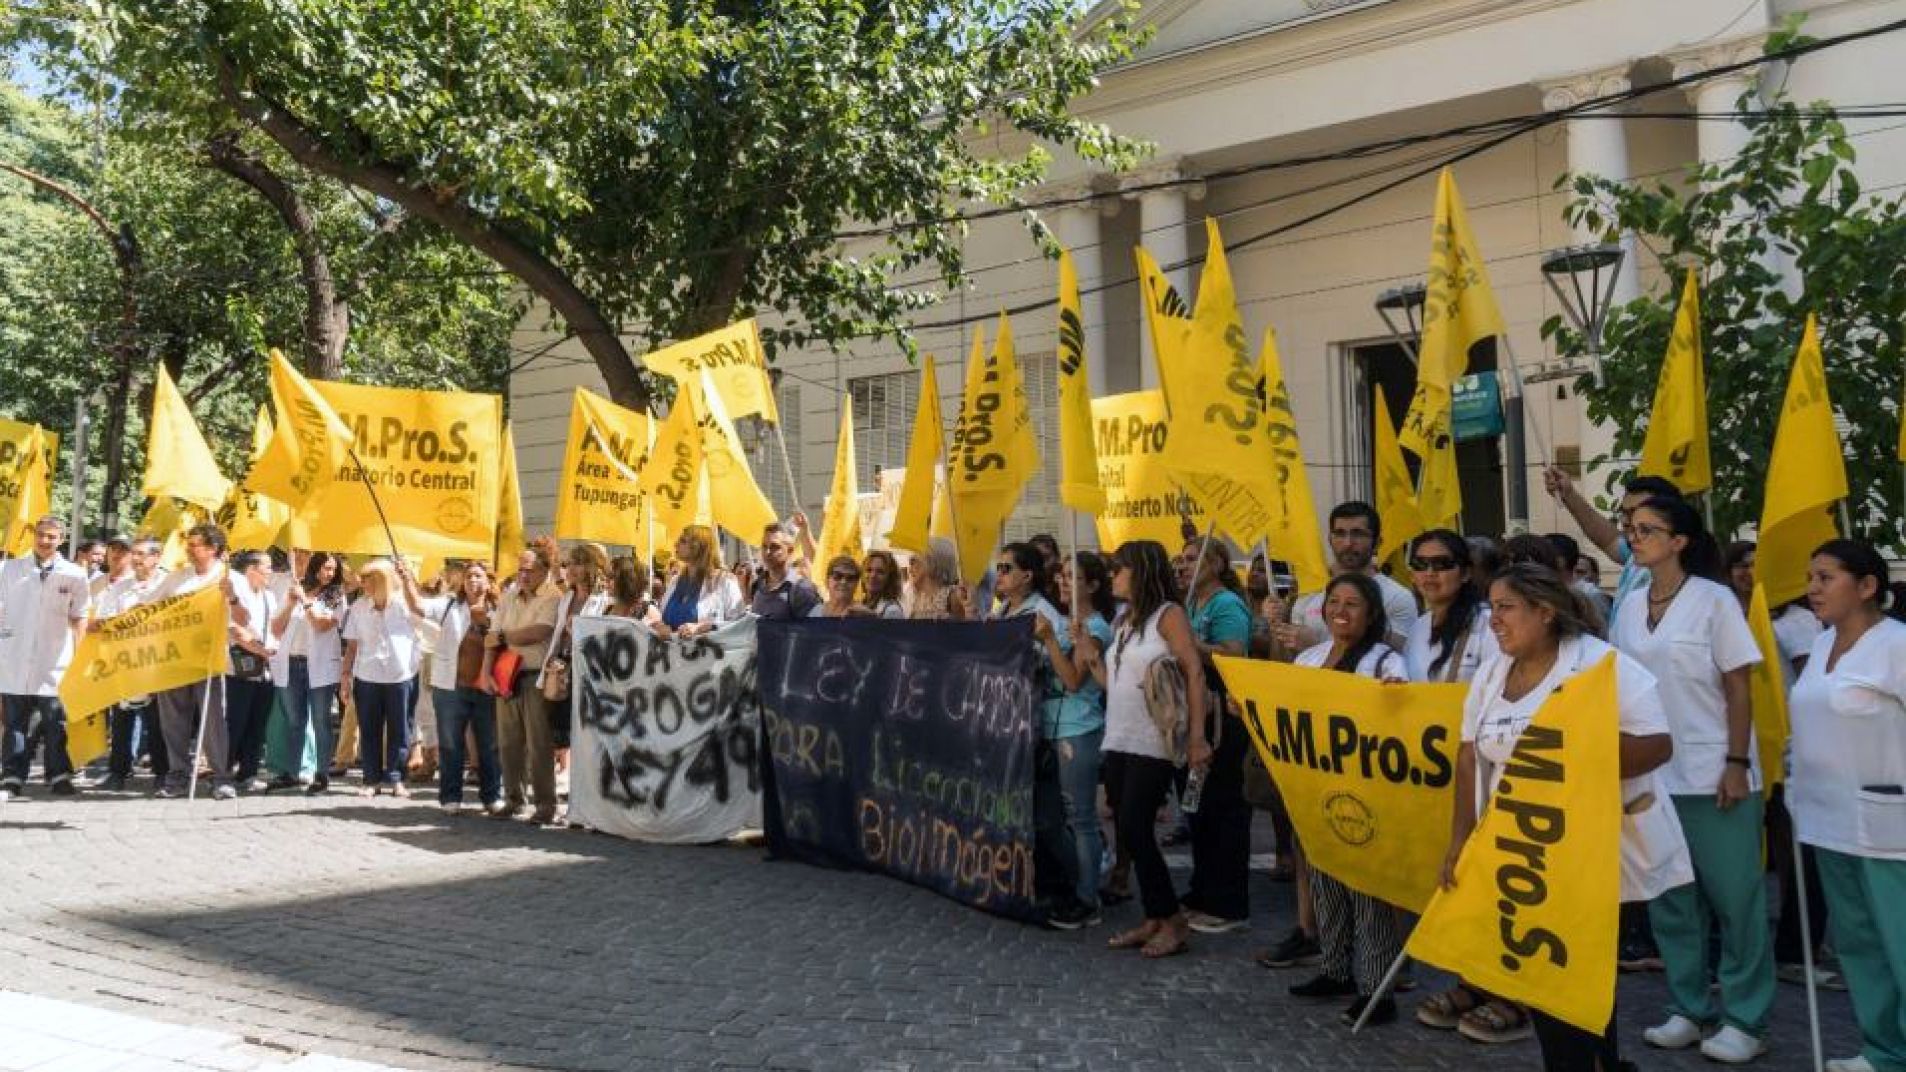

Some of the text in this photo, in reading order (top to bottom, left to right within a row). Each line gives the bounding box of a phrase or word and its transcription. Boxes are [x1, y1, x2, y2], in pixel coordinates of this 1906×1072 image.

[964, 370, 1006, 481] .Pro.S.
[335, 463, 476, 491] natorio Central
[582, 630, 637, 685] NO
[601, 742, 688, 816] LEY
